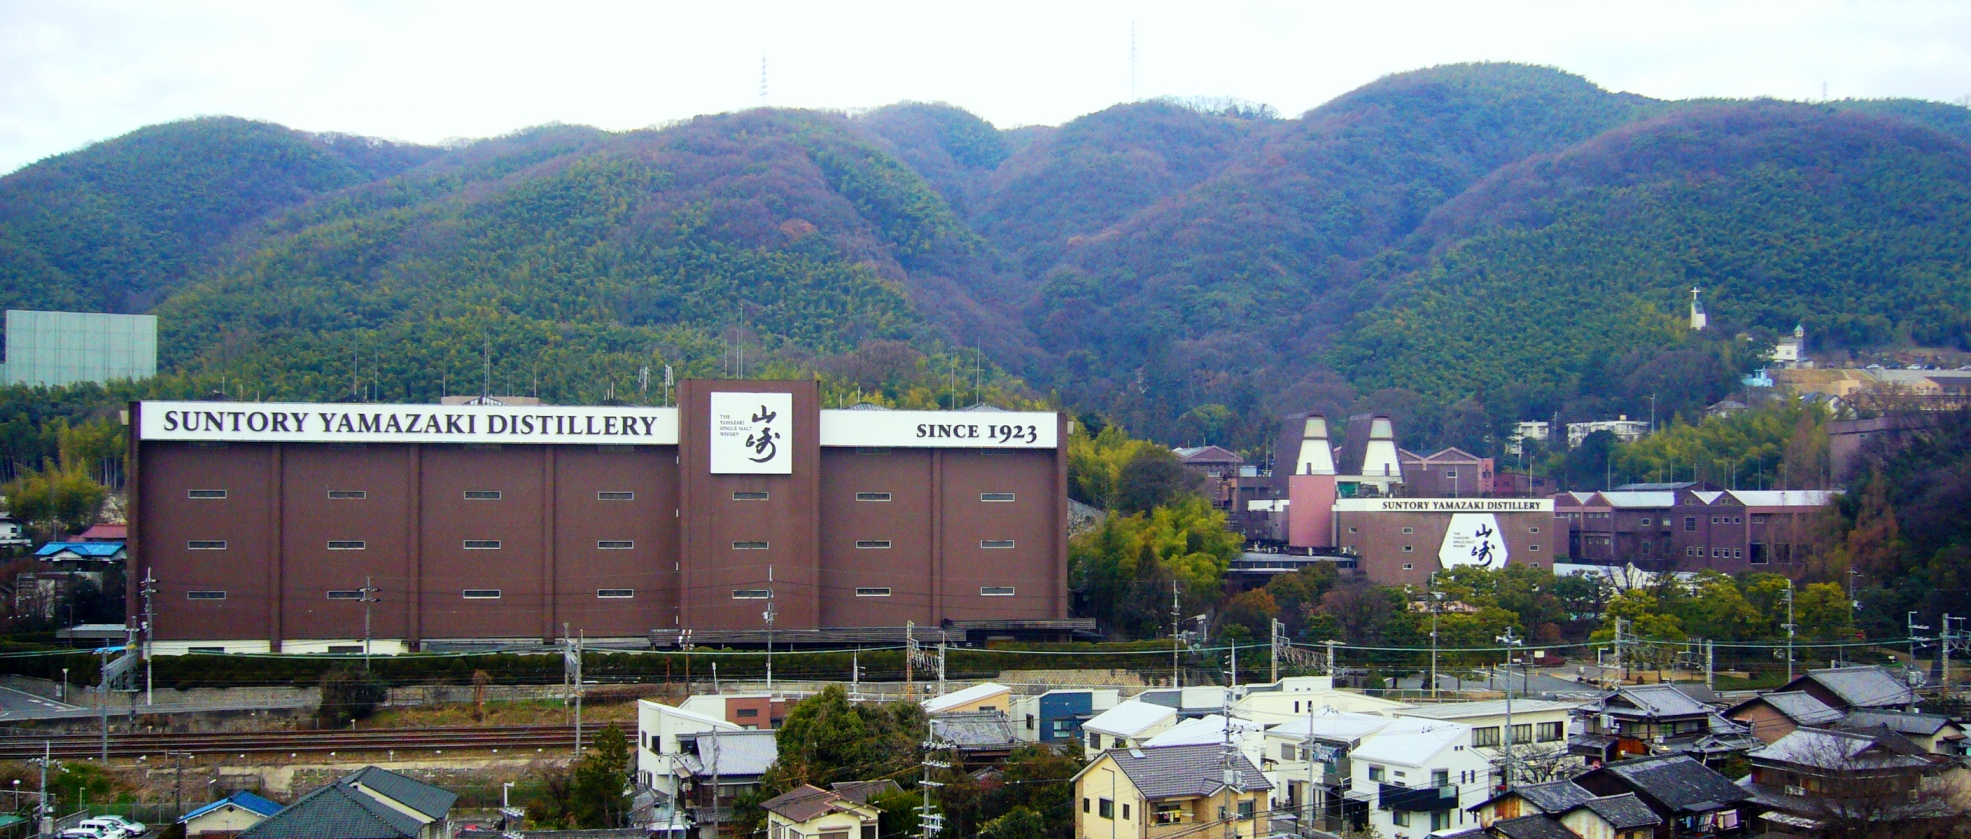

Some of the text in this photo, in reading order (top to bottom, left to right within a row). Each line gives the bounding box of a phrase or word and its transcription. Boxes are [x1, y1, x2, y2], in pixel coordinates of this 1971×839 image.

[163, 410, 658, 436] SUNTORY YAMAZAKI DISTILLERY
[916, 423, 1038, 444] SINCE 1923
[1382, 500, 1541, 510] SUNTORY YAMAZAKI DISTILLERY
